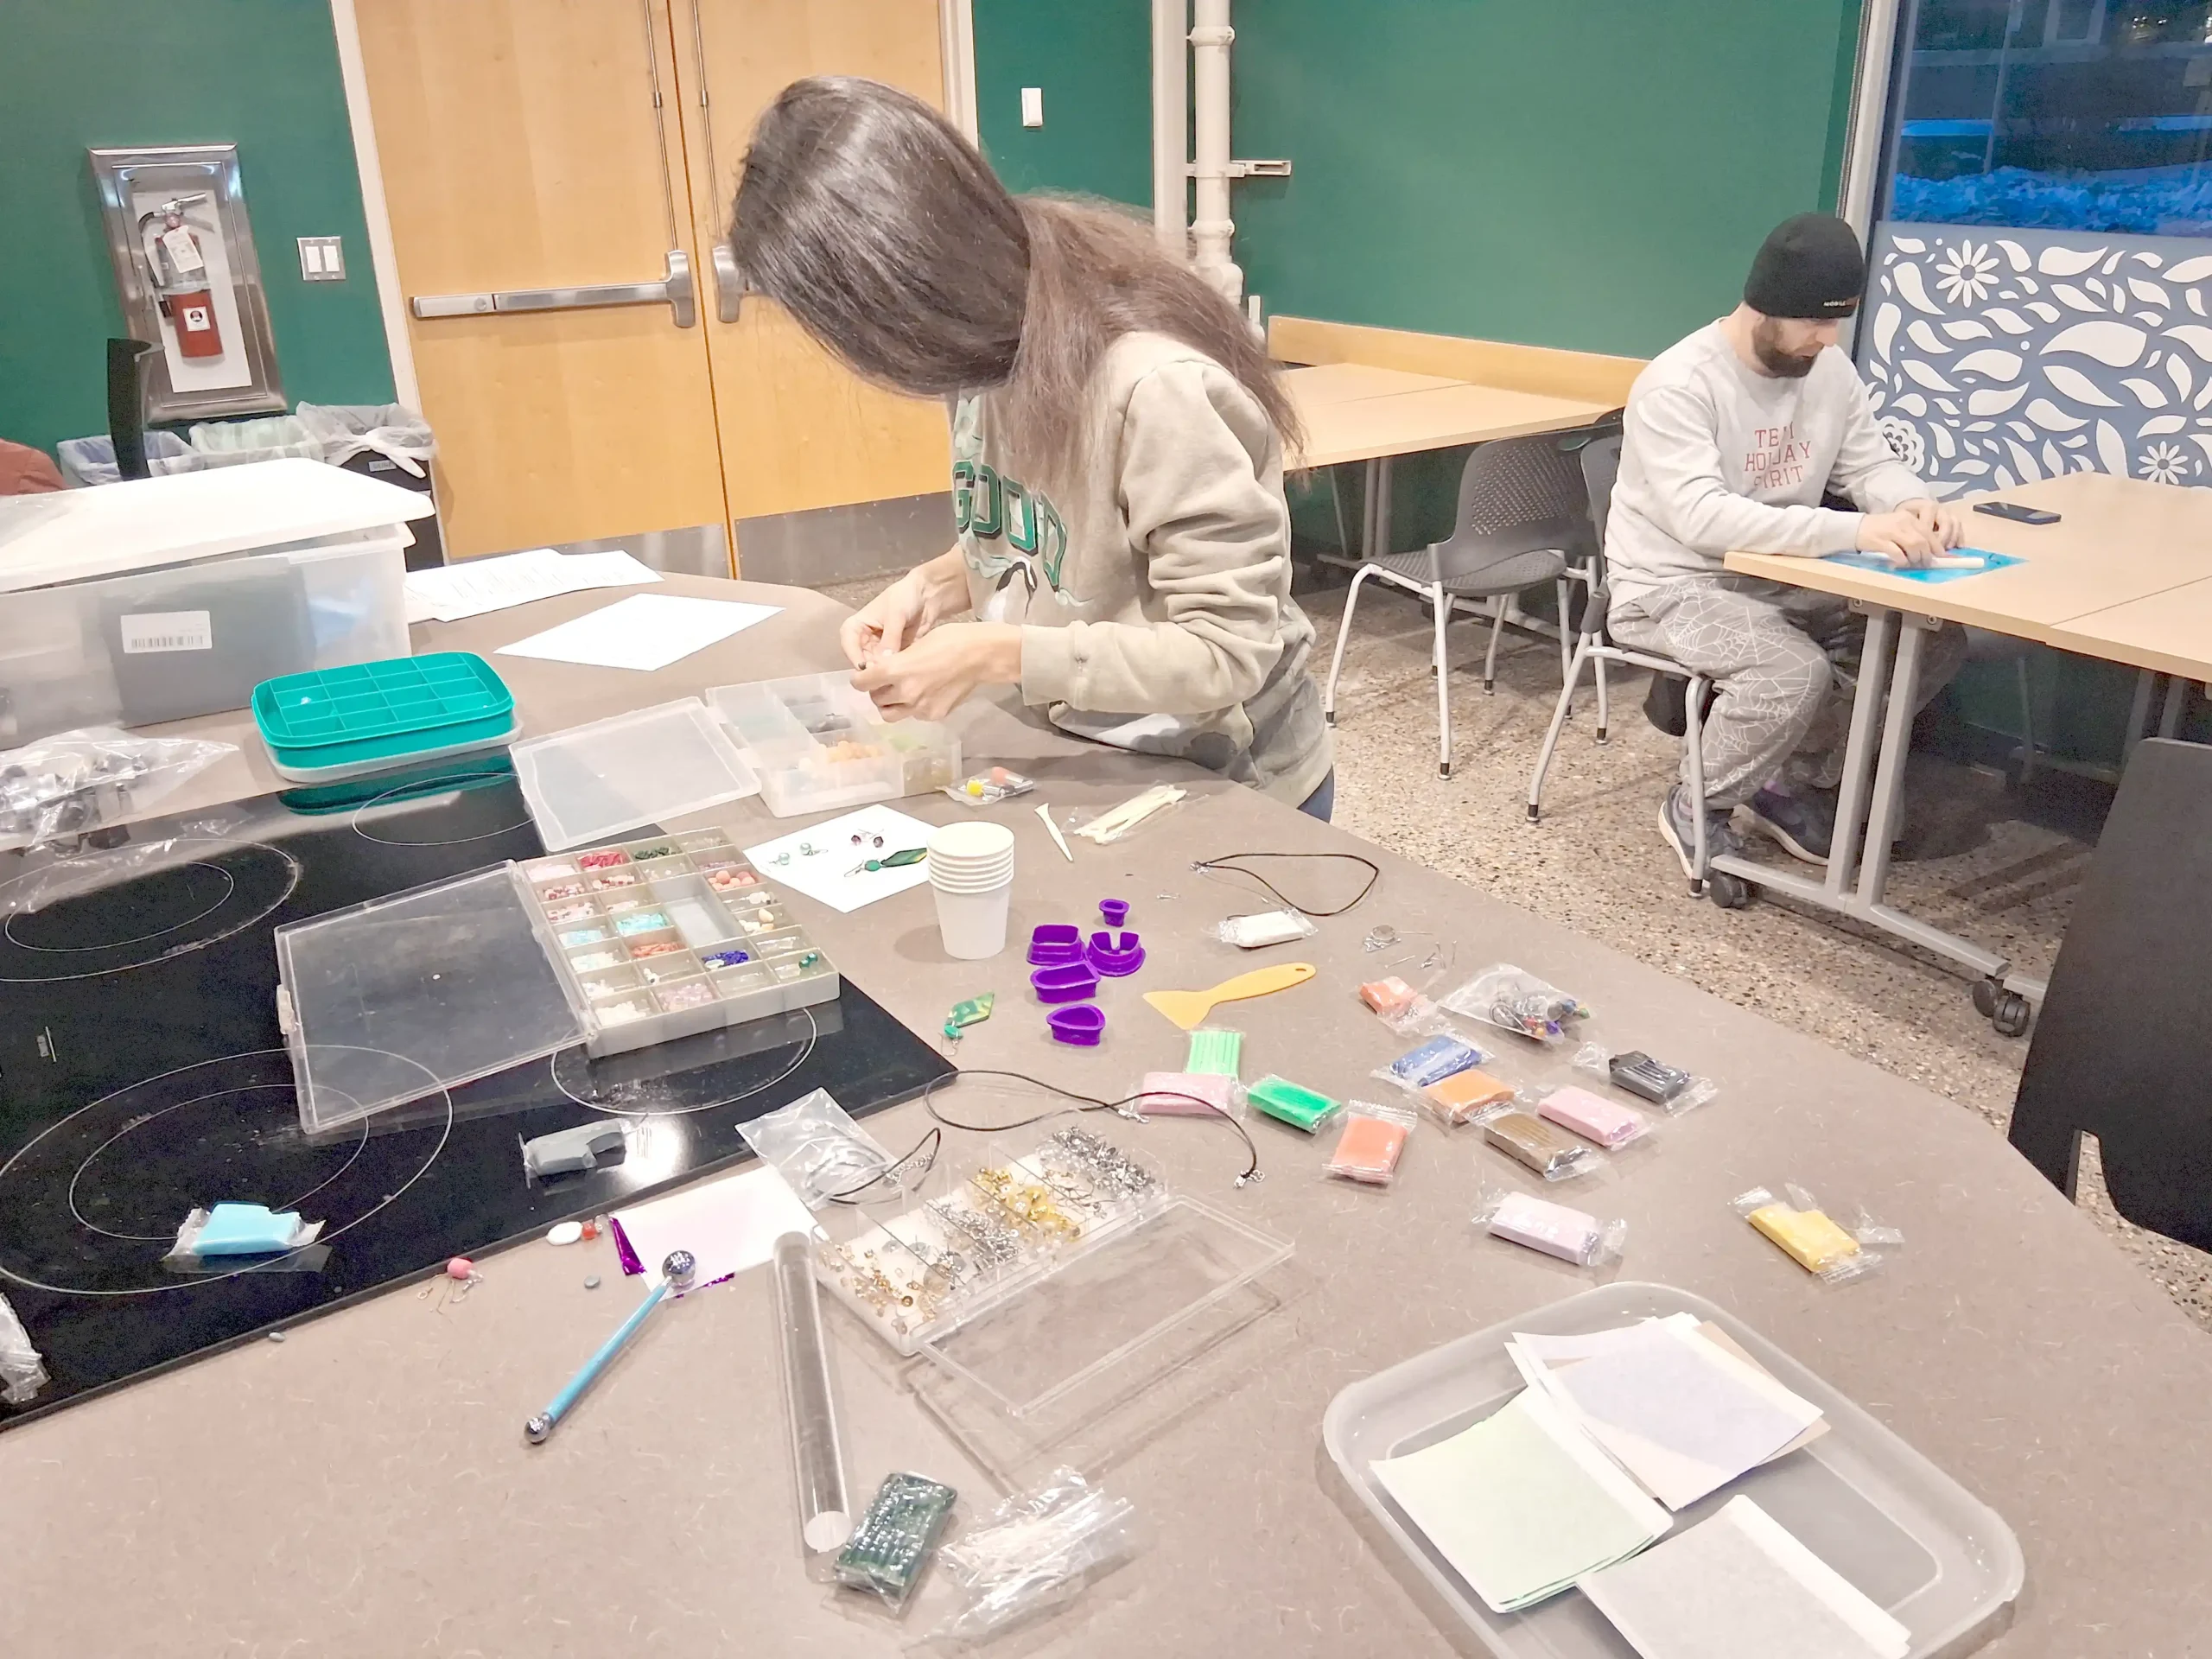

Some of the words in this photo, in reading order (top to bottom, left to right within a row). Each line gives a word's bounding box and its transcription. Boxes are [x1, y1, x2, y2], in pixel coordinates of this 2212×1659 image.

[1754, 421, 1795, 448] TE
[1745, 440, 1812, 472] HOAY
[1753, 464, 1804, 489] IRIT
